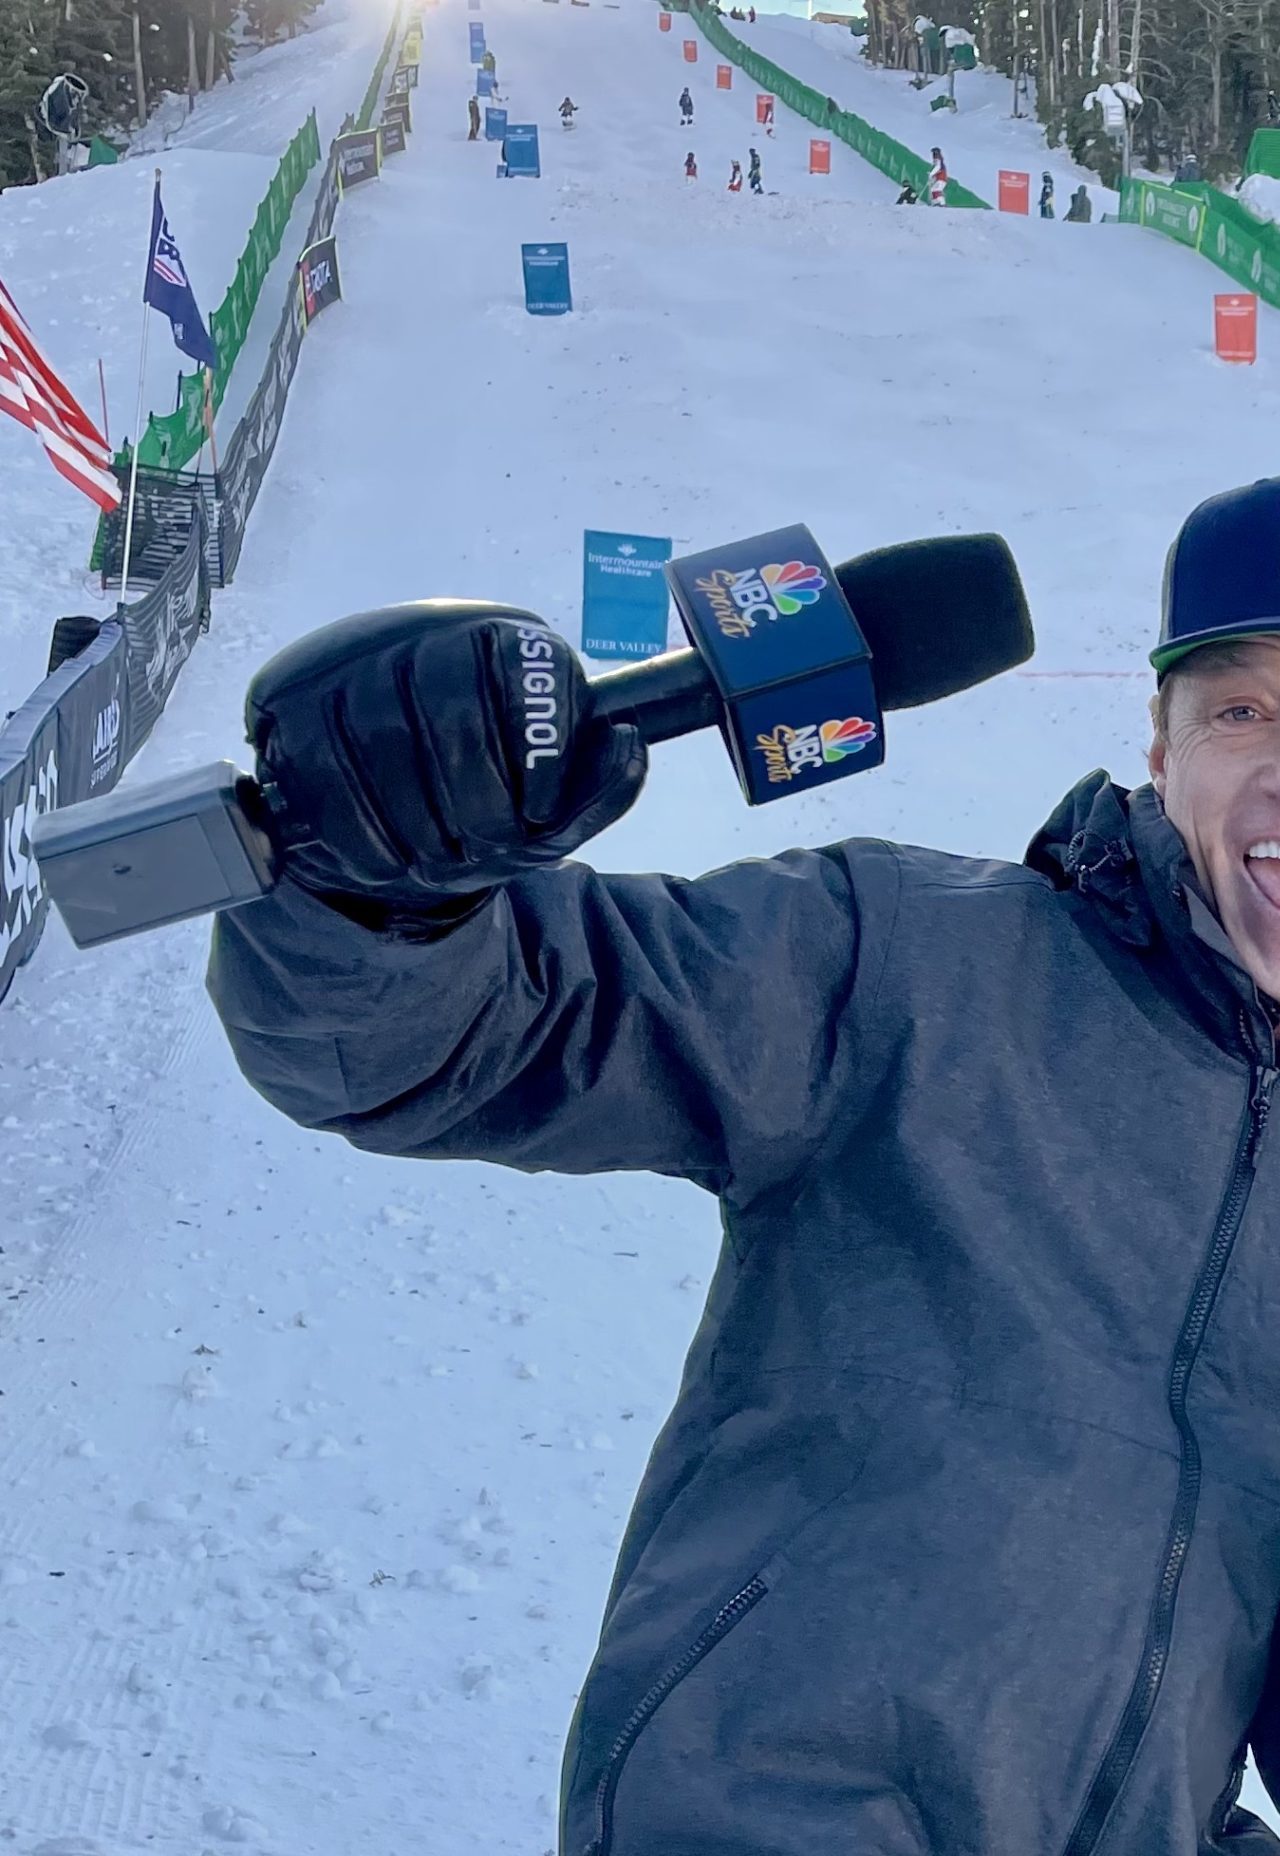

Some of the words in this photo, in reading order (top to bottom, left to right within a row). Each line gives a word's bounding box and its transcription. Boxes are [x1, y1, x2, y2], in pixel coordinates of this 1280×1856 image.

[600, 564, 652, 578] Healthcare
[696, 569, 750, 639] Sports
[731, 567, 778, 629] NBC
[586, 638, 616, 650] DEER
[620, 641, 661, 654] VALLEY
[787, 724, 824, 776] NBC
